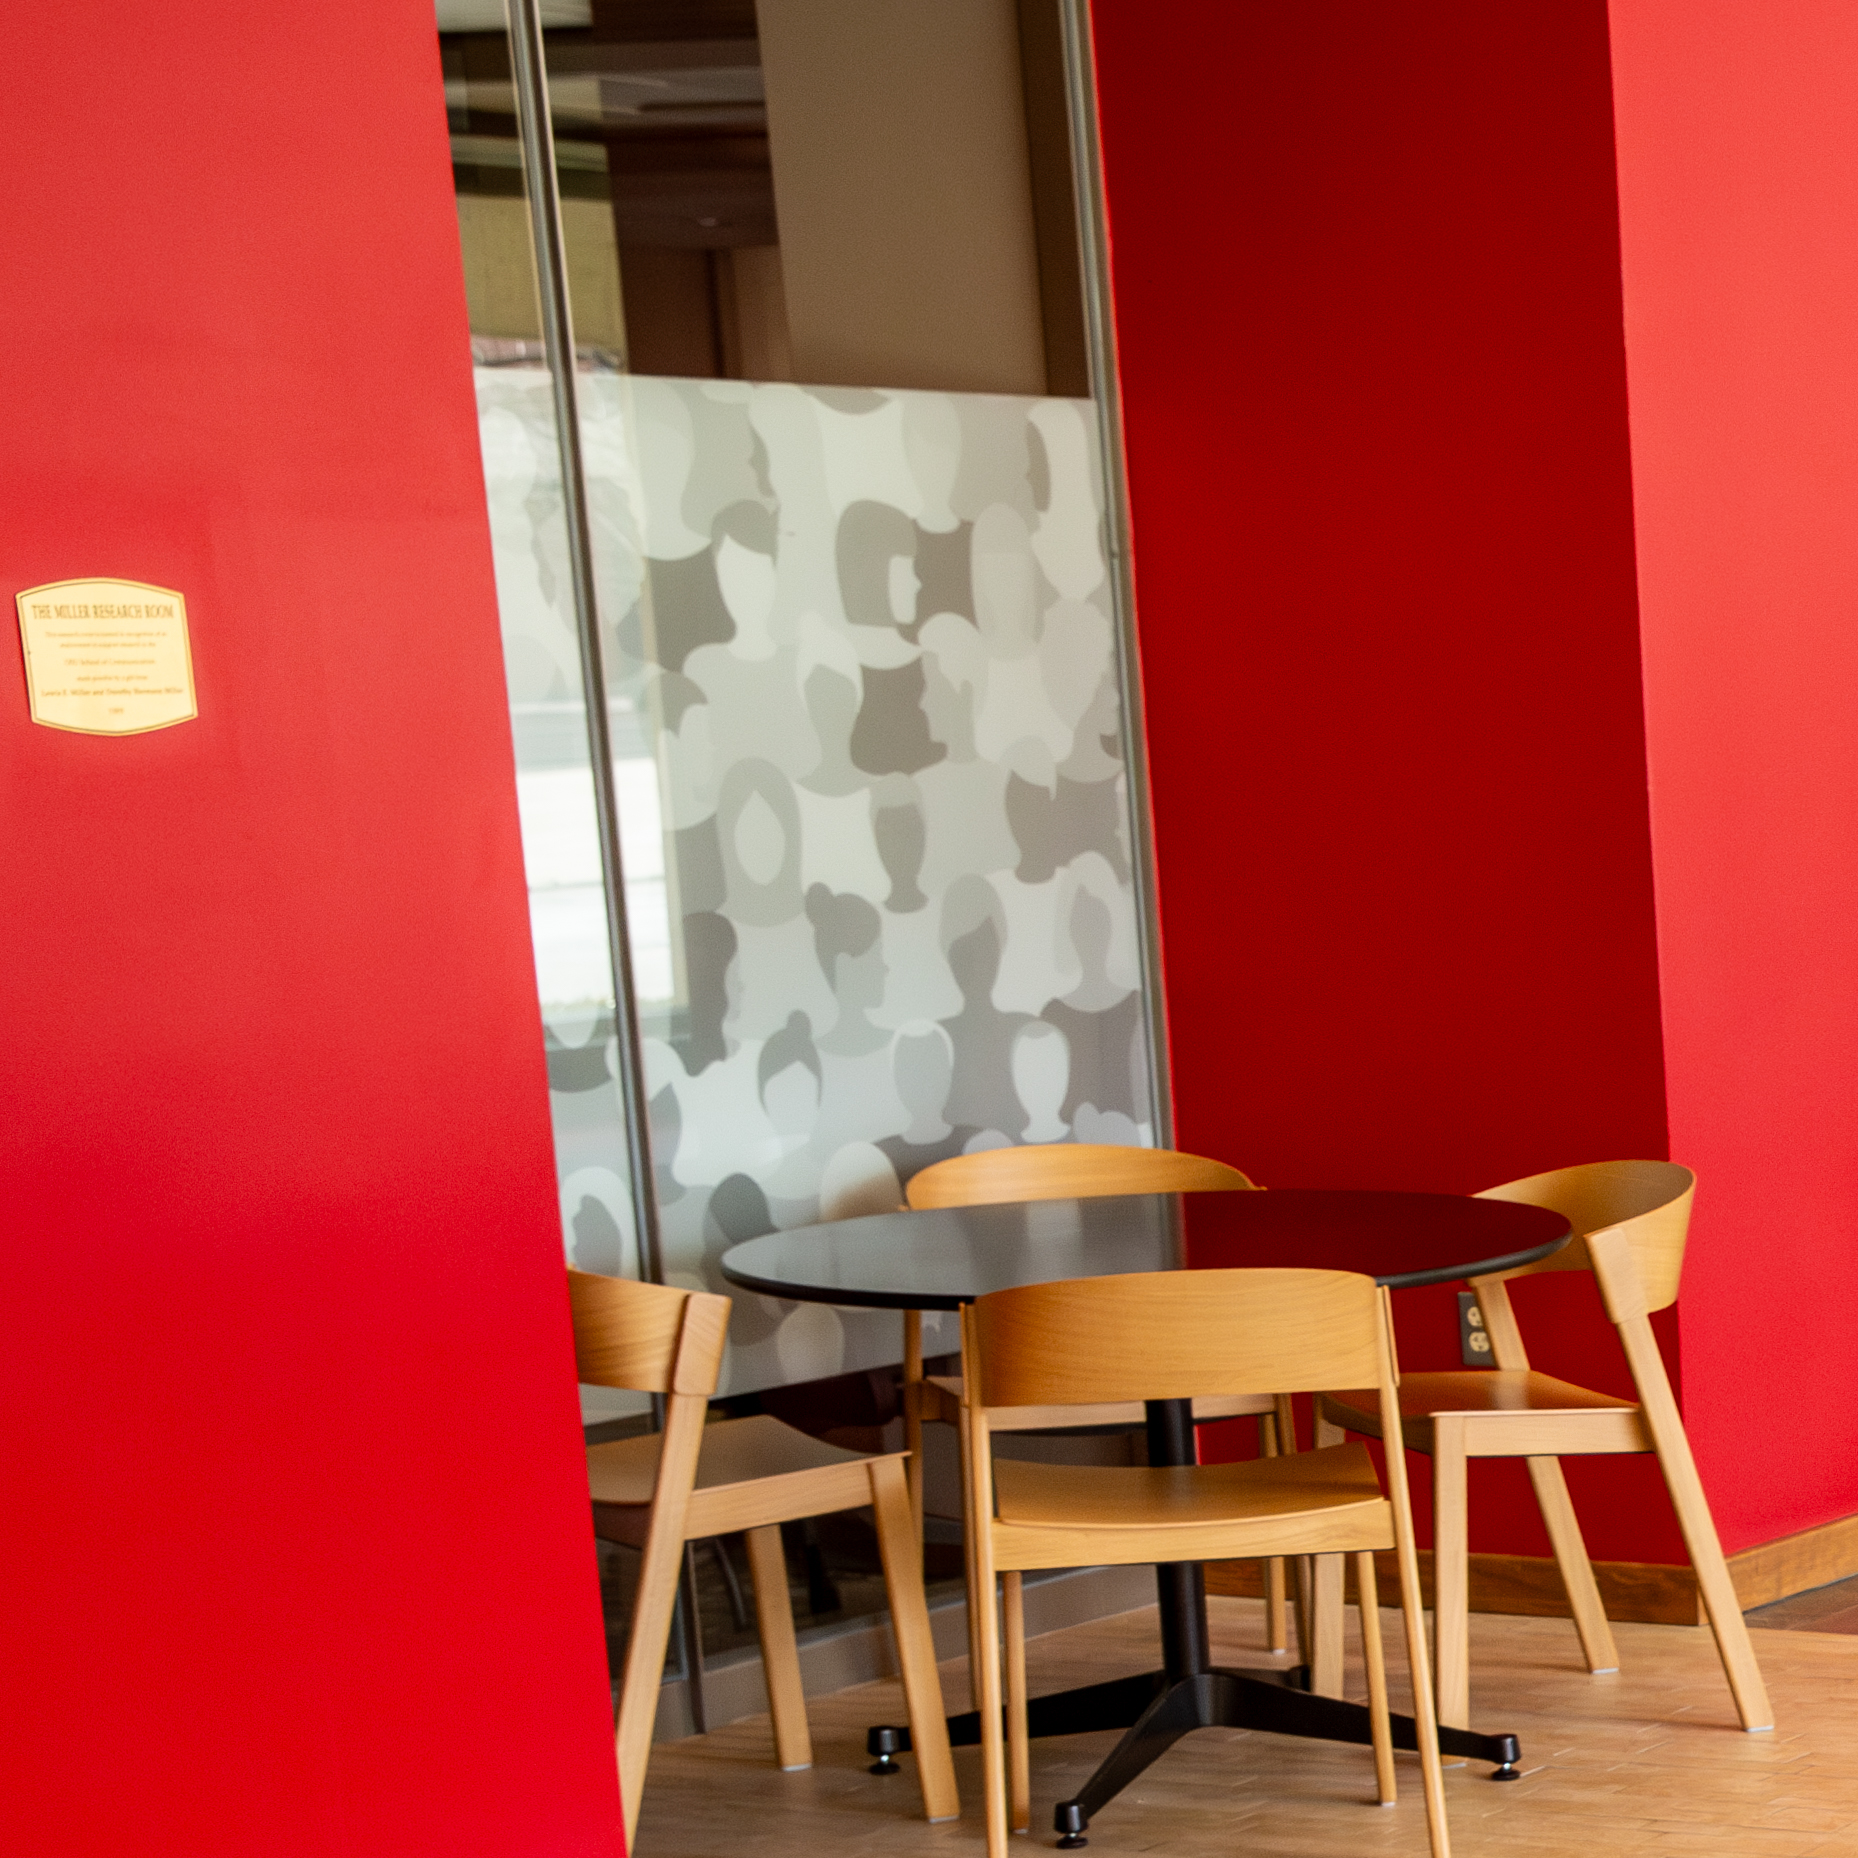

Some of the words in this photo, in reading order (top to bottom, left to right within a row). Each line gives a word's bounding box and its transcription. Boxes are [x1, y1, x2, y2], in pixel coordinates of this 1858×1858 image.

[31, 604, 52, 619] THE
[54, 604, 90, 619] MILLER
[92, 604, 142, 619] RESEARCH
[144, 604, 174, 619] ROOM
